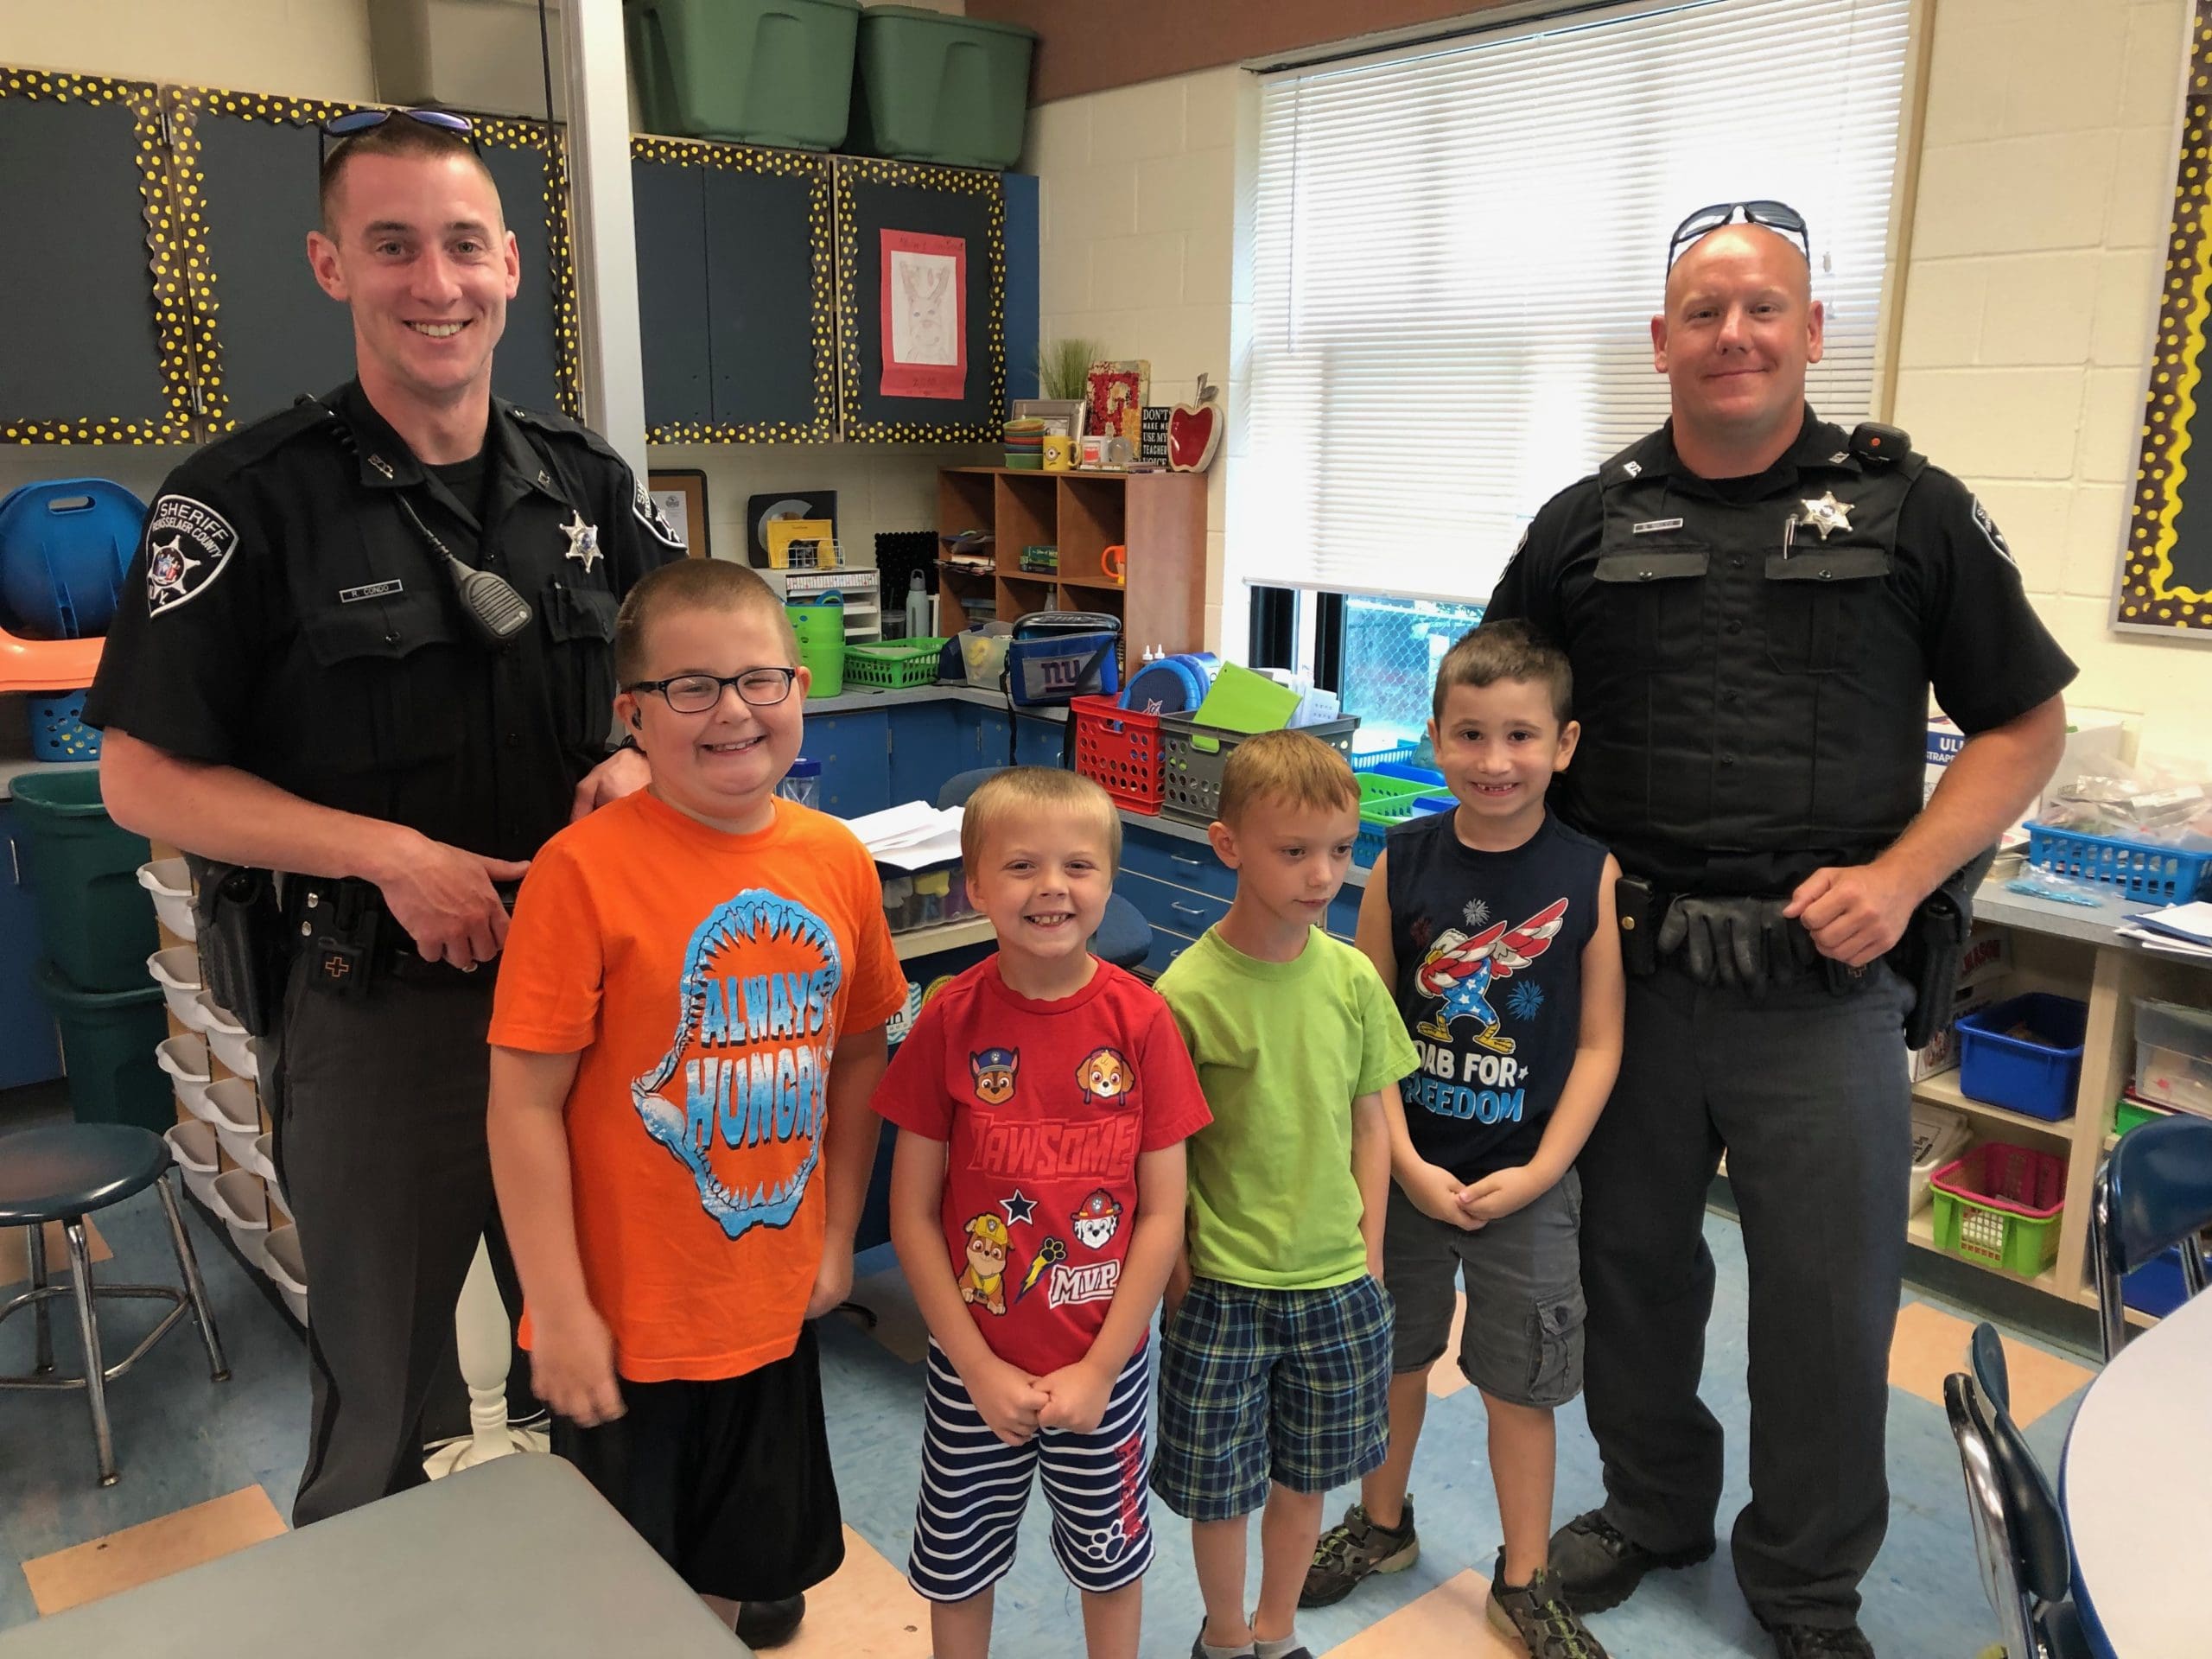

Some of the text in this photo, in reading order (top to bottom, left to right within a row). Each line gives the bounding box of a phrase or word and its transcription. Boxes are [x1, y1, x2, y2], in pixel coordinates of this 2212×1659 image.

[1143, 409, 1168, 421] DON'T
[1143, 422, 1158, 430] MAKE
[1143, 432, 1156, 442] USE
[160, 503, 229, 540] SHERIFF
[191, 528, 223, 558] COUNTY
[363, 584, 389, 595] CONDO
[700, 969, 828, 1048] ALWAYS
[1463, 1052, 1518, 1088] FOR
[1401, 1072, 1526, 1124] REEDOM
[1050, 1259, 1121, 1306] MVP
